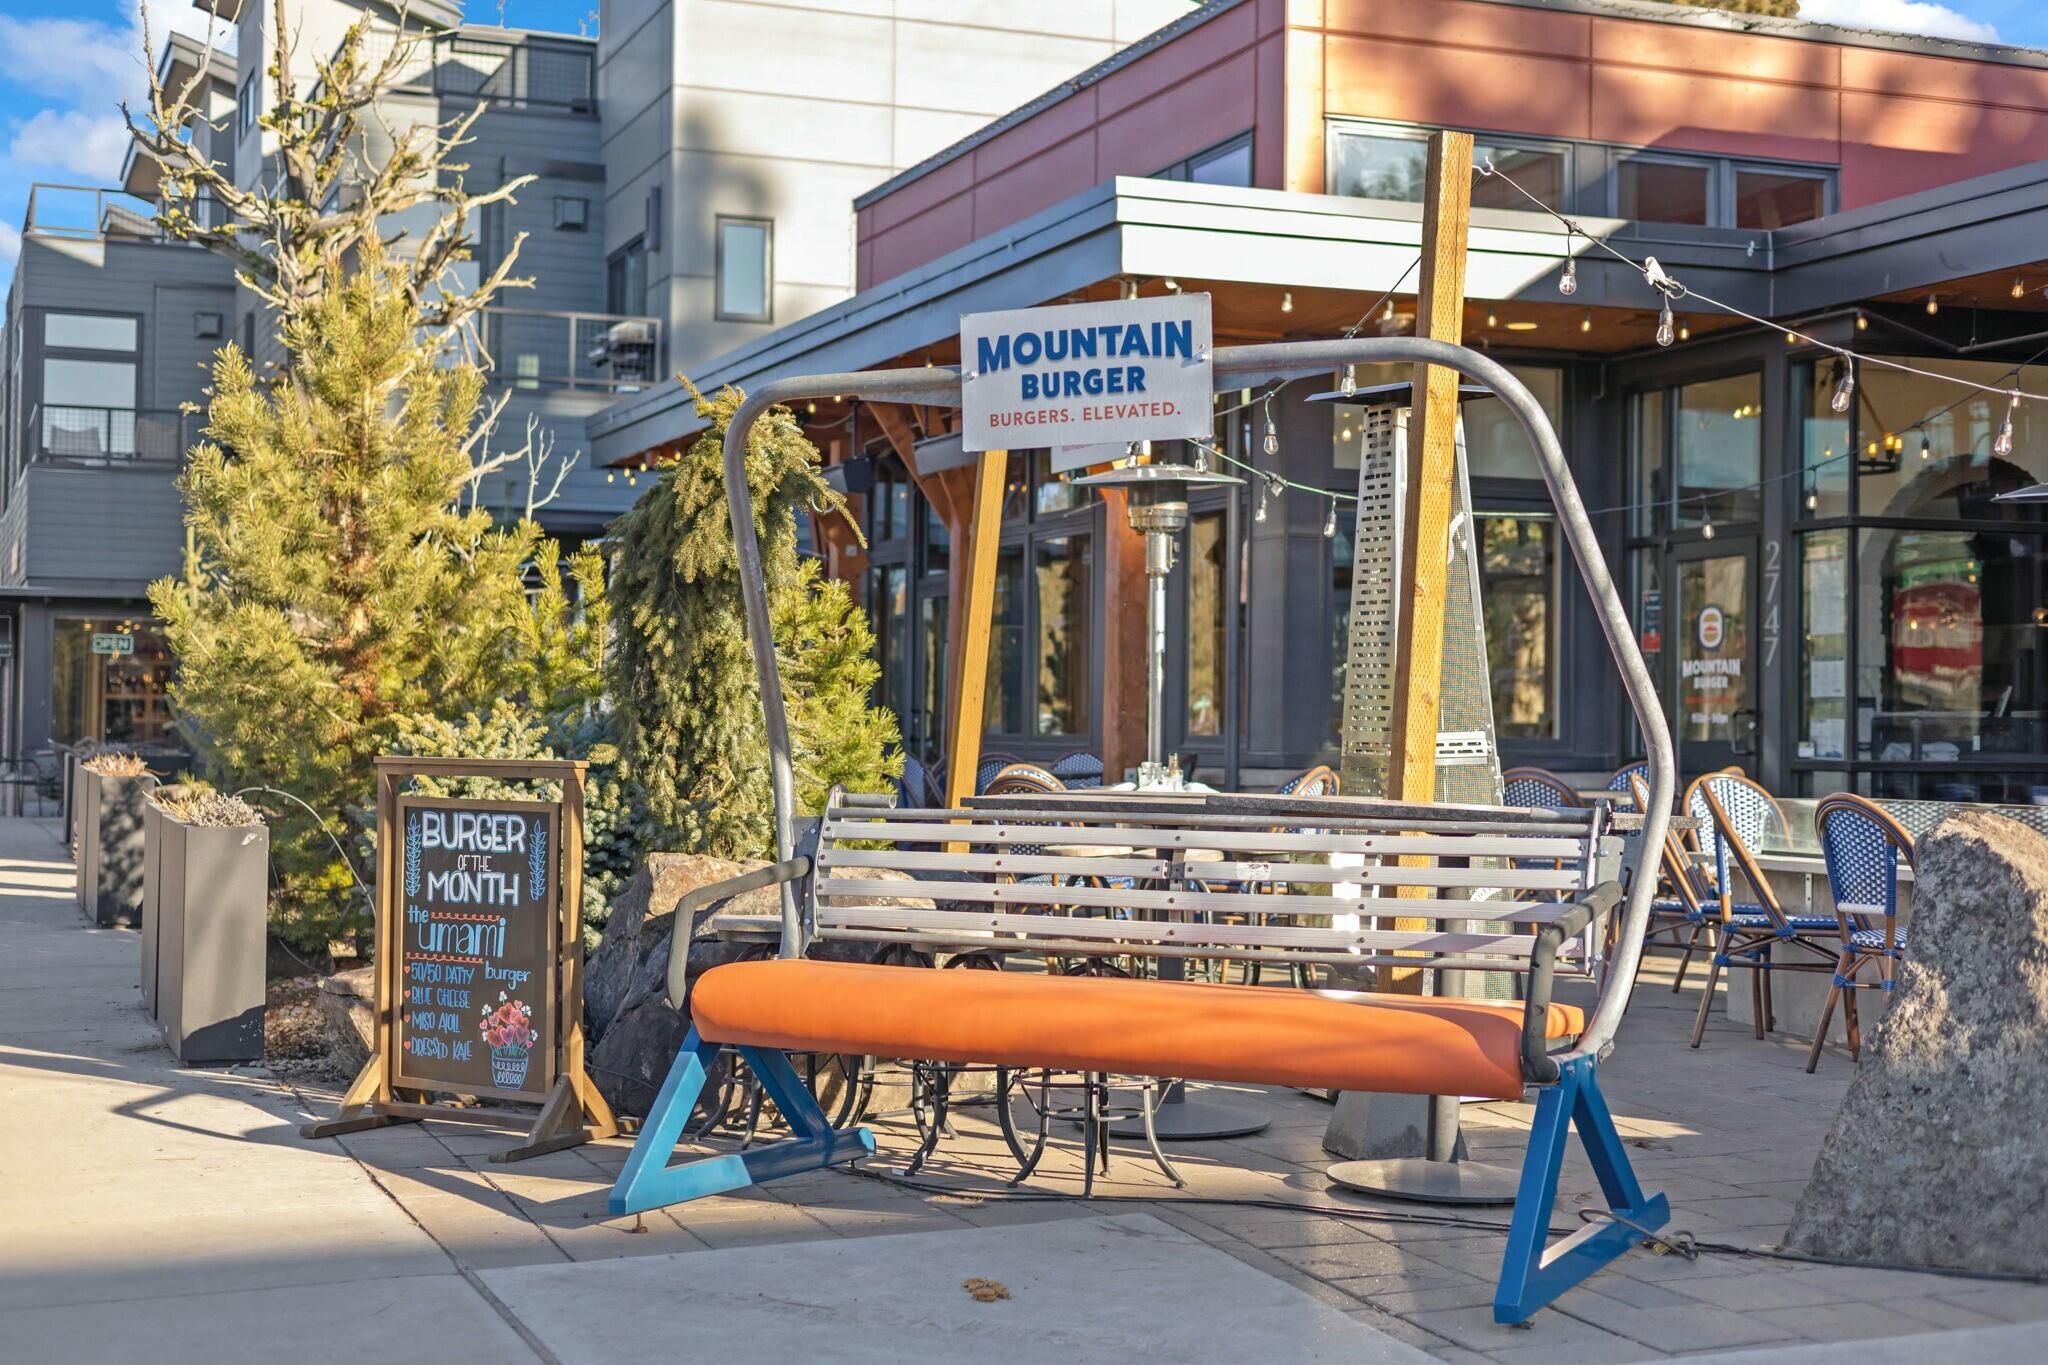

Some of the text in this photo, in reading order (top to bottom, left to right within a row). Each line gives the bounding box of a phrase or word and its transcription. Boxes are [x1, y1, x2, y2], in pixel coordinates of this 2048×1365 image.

[977, 320, 1193, 375] MOUNTAIN
[1021, 366, 1146, 400] BURGER
[990, 402, 1181, 428] BURGERS. ELEVATED.
[1764, 540, 1780, 667] 2747
[1682, 658, 1741, 677] MOUNTAIN
[1693, 676, 1728, 689] BURGER
[422, 811, 525, 853] BURGER
[457, 854, 492, 872] OF THE
[427, 871, 519, 905] MONTH
[408, 904, 429, 924] the
[418, 918, 506, 957] umami
[411, 962, 475, 984] 50/50 PATTY
[485, 961, 531, 990] burger
[411, 986, 471, 1009] BLUE CHEESE
[411, 1011, 435, 1031] MISO
[411, 1037, 473, 1061] DRESSED KALE
